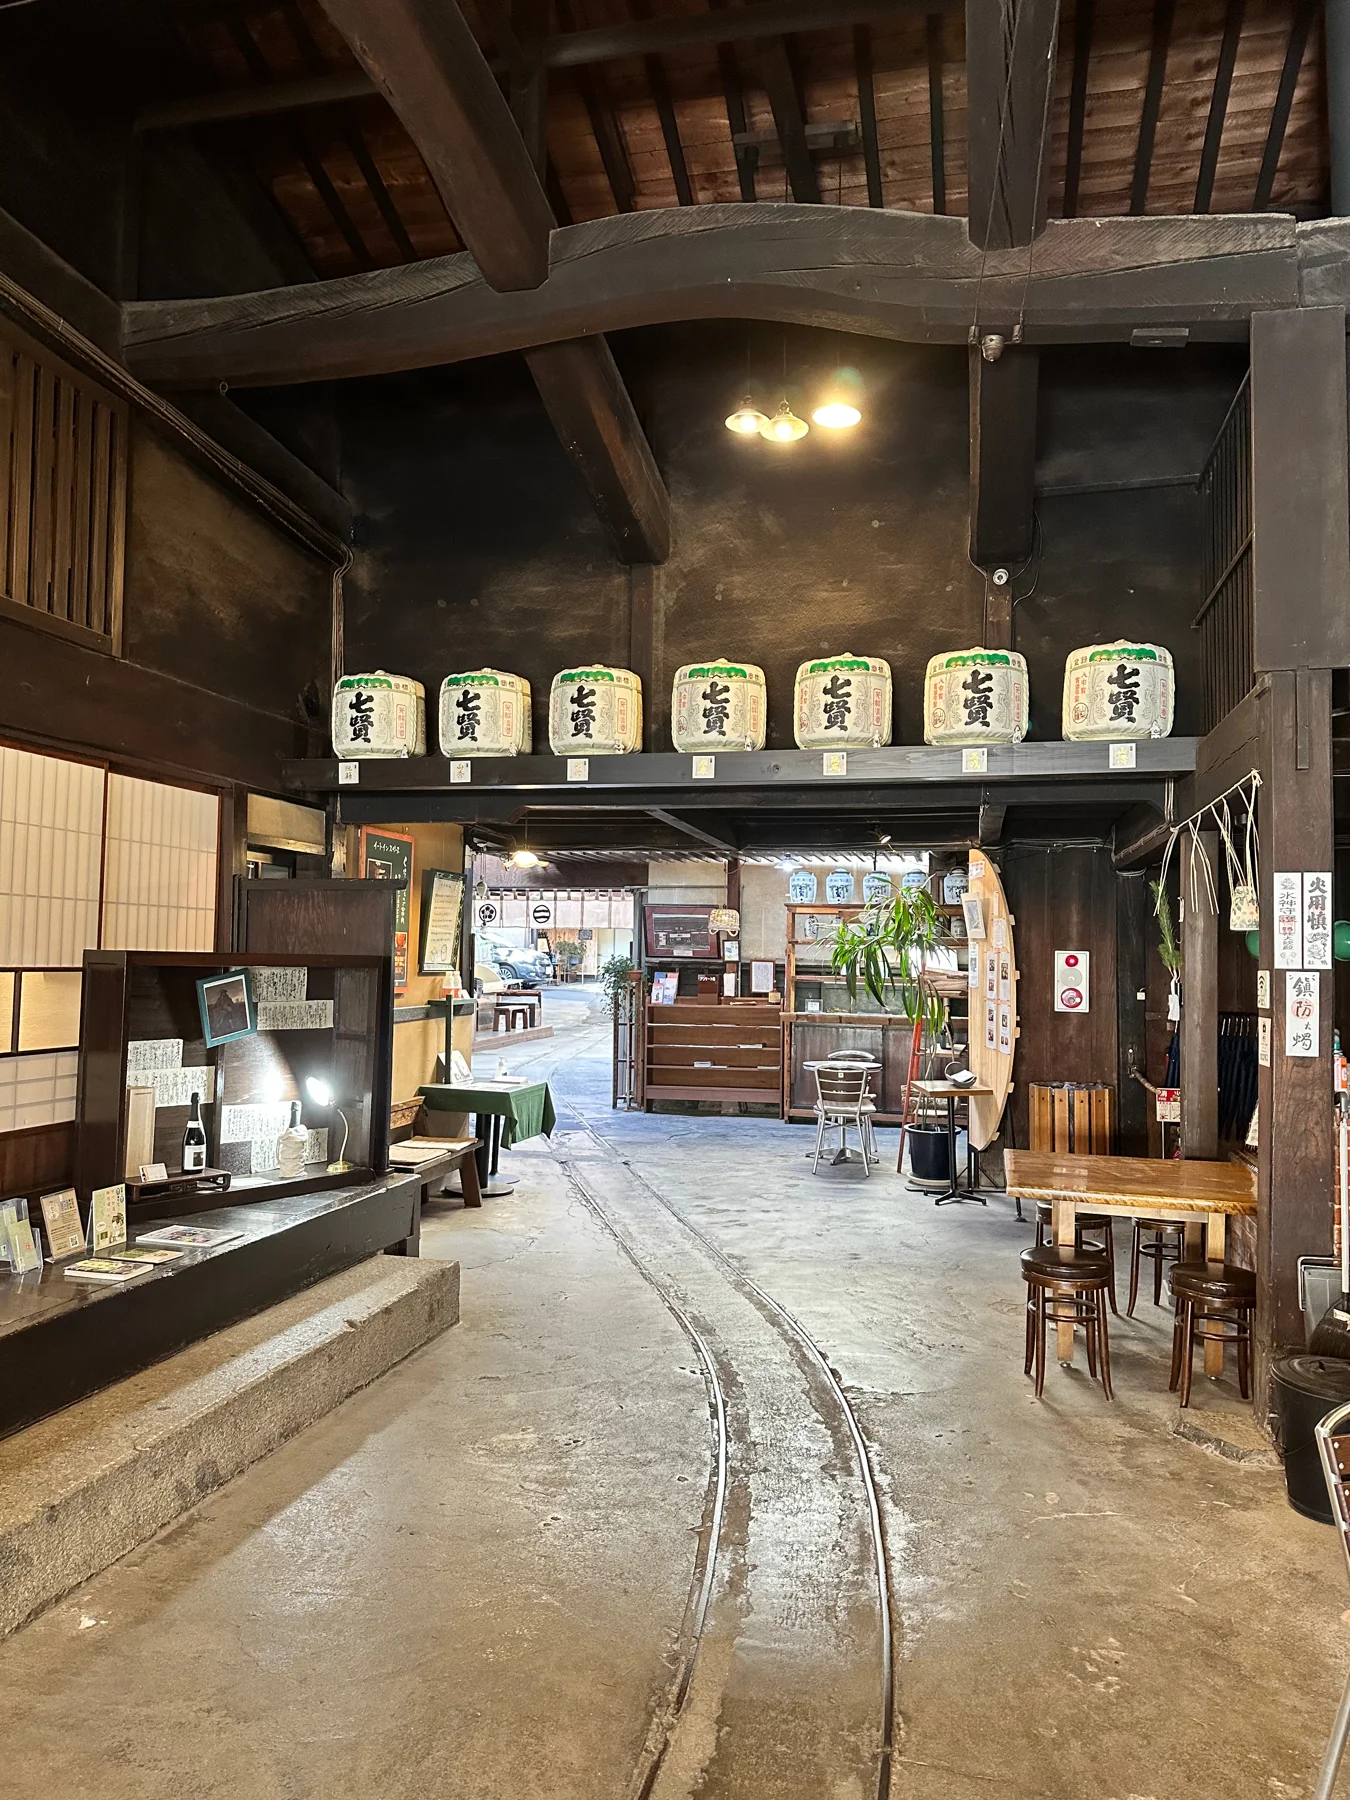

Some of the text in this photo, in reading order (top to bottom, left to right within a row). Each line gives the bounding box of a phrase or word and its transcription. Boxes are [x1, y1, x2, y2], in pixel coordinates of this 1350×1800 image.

[349, 691, 375, 744] 七賢
[456, 689, 482, 742] 七賢
[570, 685, 597, 739] 七賢
[701, 681, 731, 737] 七賢
[822, 674, 852, 732] 七賢
[962, 669, 994, 728] 七賢
[1107, 663, 1141, 724] 七賢
[1307, 876, 1328, 931] 火用慎
